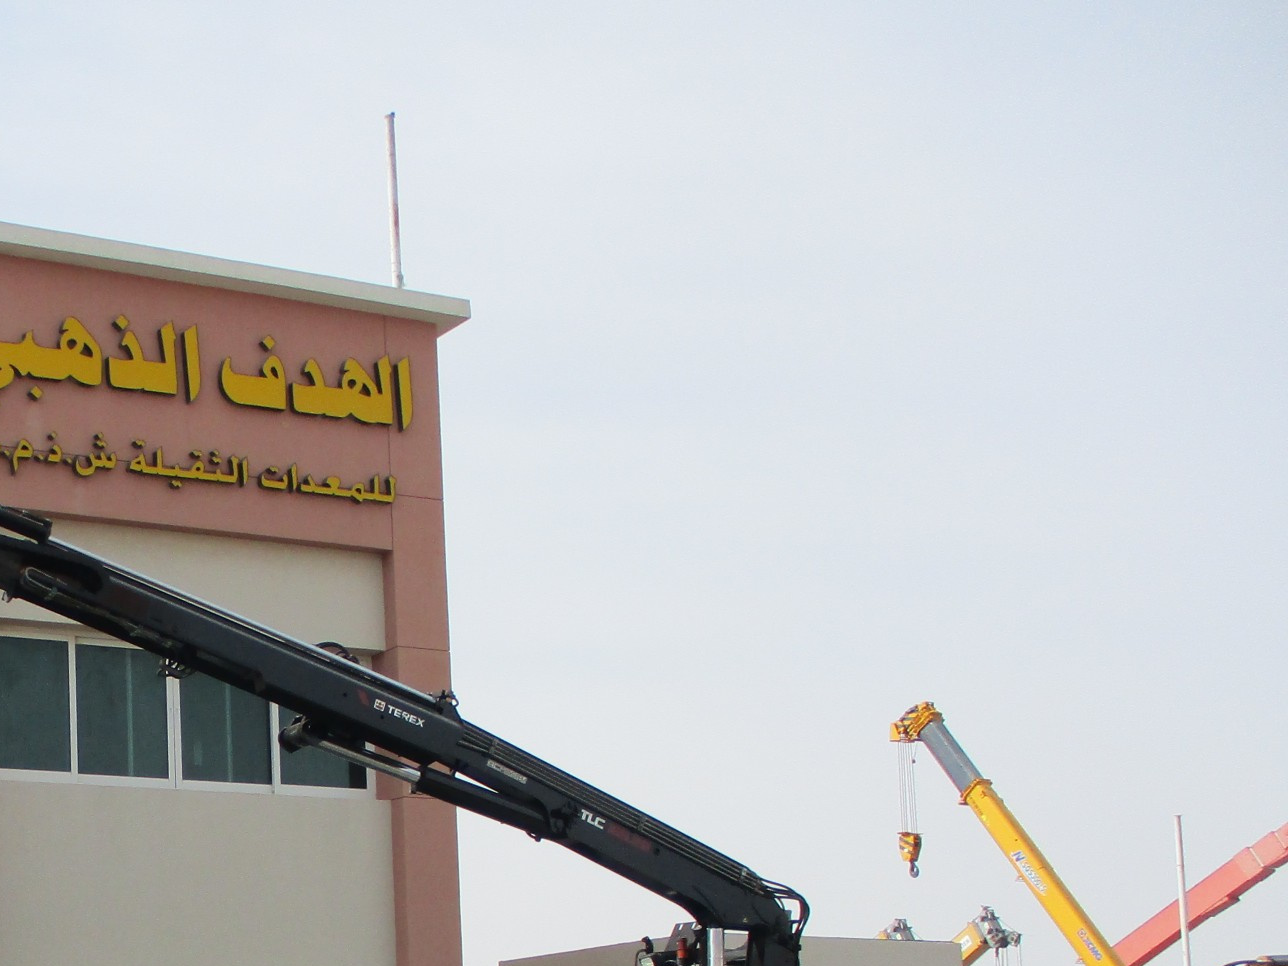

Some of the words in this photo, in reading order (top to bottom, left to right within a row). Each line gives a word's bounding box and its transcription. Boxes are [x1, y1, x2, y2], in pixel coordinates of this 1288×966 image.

[221, 335, 412, 431] الهدف
[129, 439, 248, 489] الثقيلة
[261, 463, 396, 503] للمعدات
[387, 704, 426, 728] TEREX
[580, 808, 606, 830] TLC
